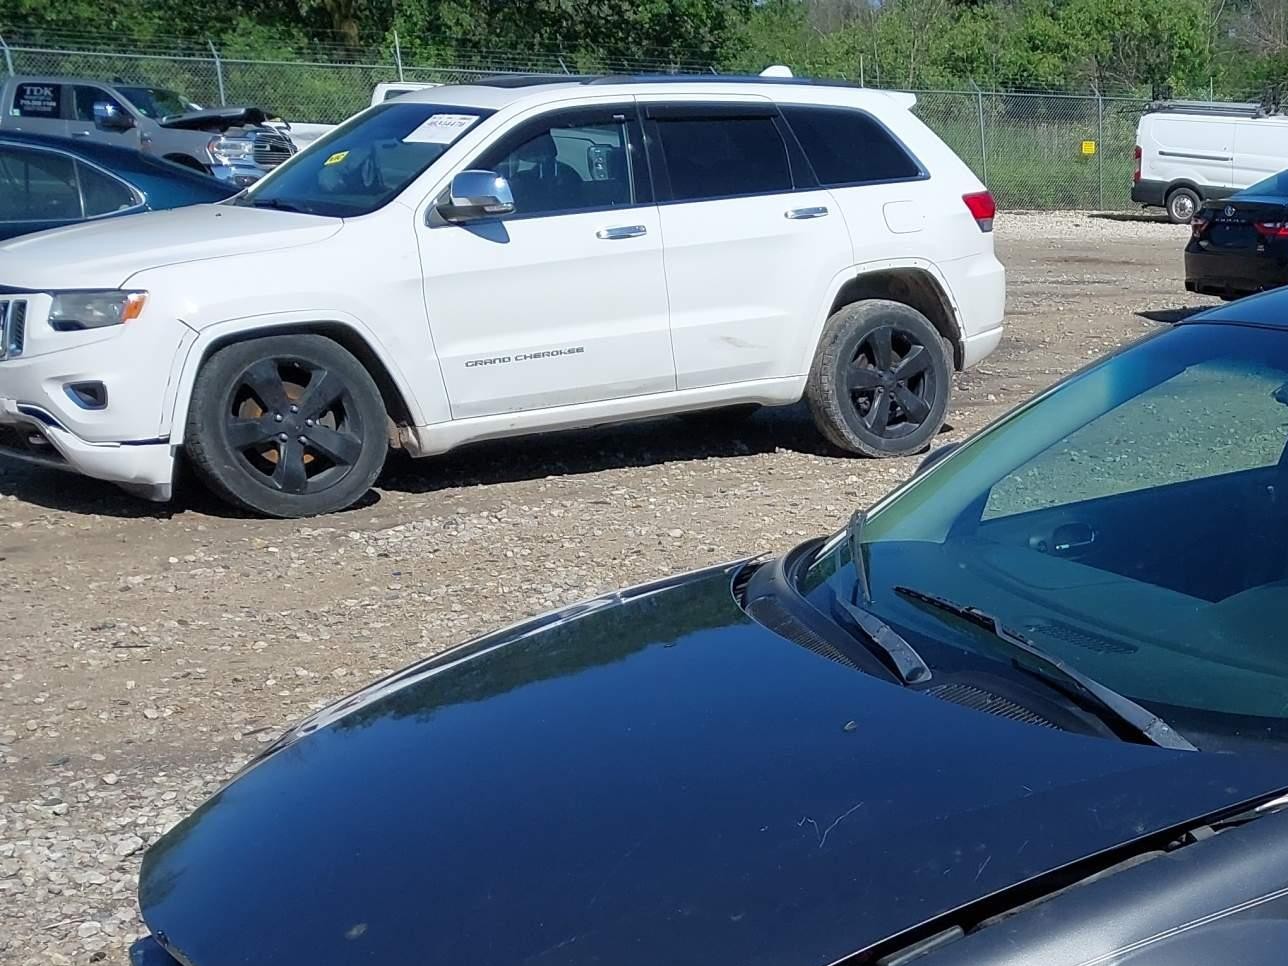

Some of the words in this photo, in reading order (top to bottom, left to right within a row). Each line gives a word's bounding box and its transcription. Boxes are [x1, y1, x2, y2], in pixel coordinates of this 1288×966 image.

[23, 86, 53, 97] TDK
[465, 356, 511, 368] GRAND
[514, 346, 585, 361] CHEROKEE
